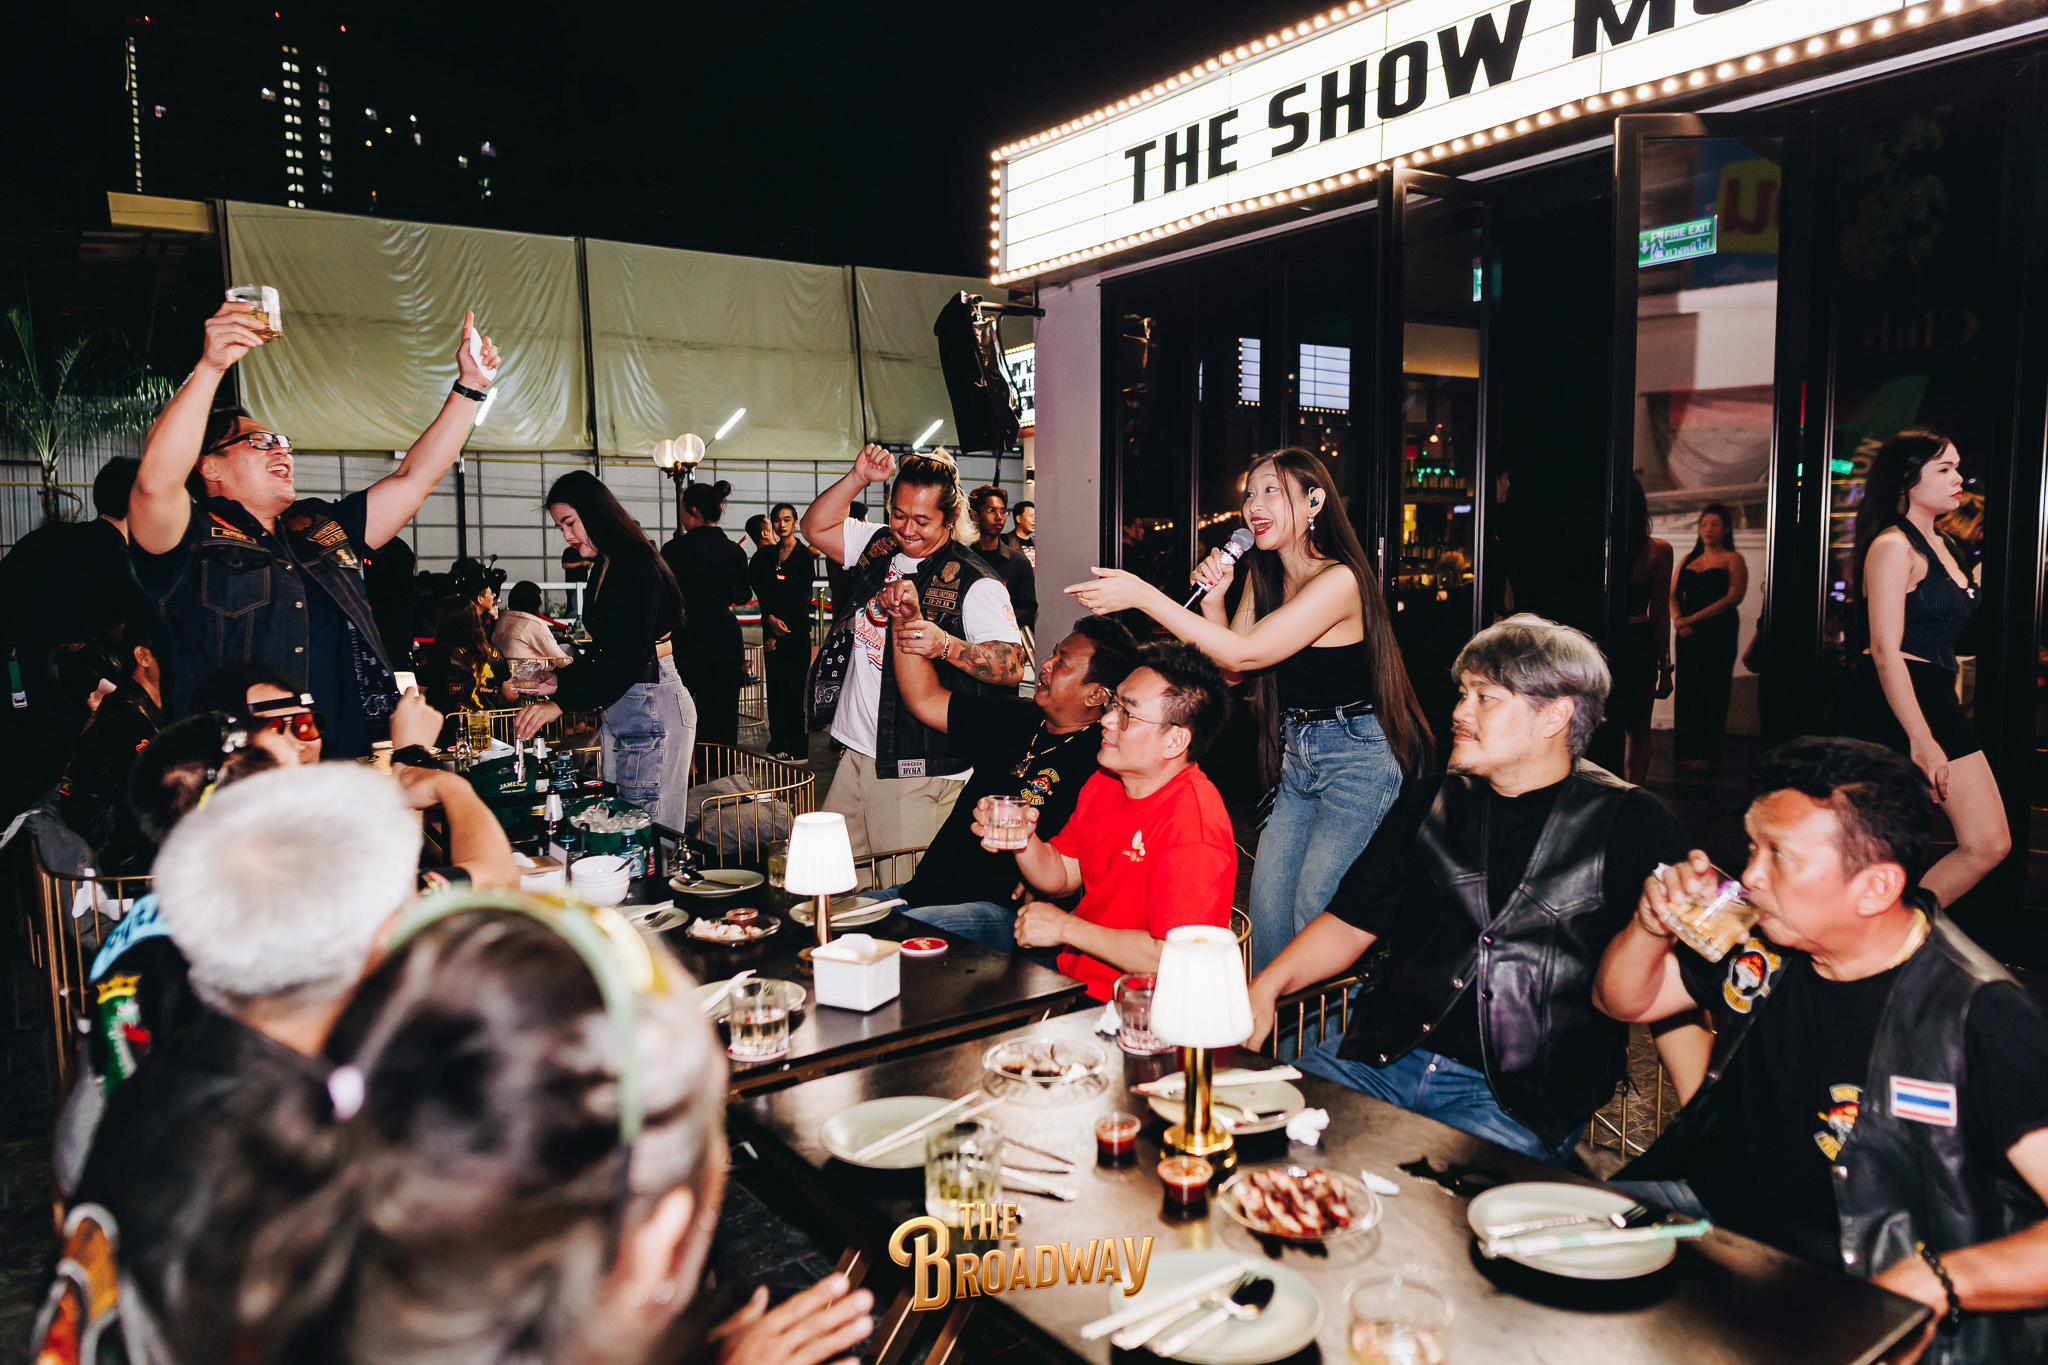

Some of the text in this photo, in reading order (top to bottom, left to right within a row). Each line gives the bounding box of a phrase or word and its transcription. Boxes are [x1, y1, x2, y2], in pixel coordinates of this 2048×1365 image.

[1125, 0, 1752, 204] THE SHOW M
[1664, 221, 1712, 240] FIRE EXIT
[903, 767, 922, 775] DYNA
